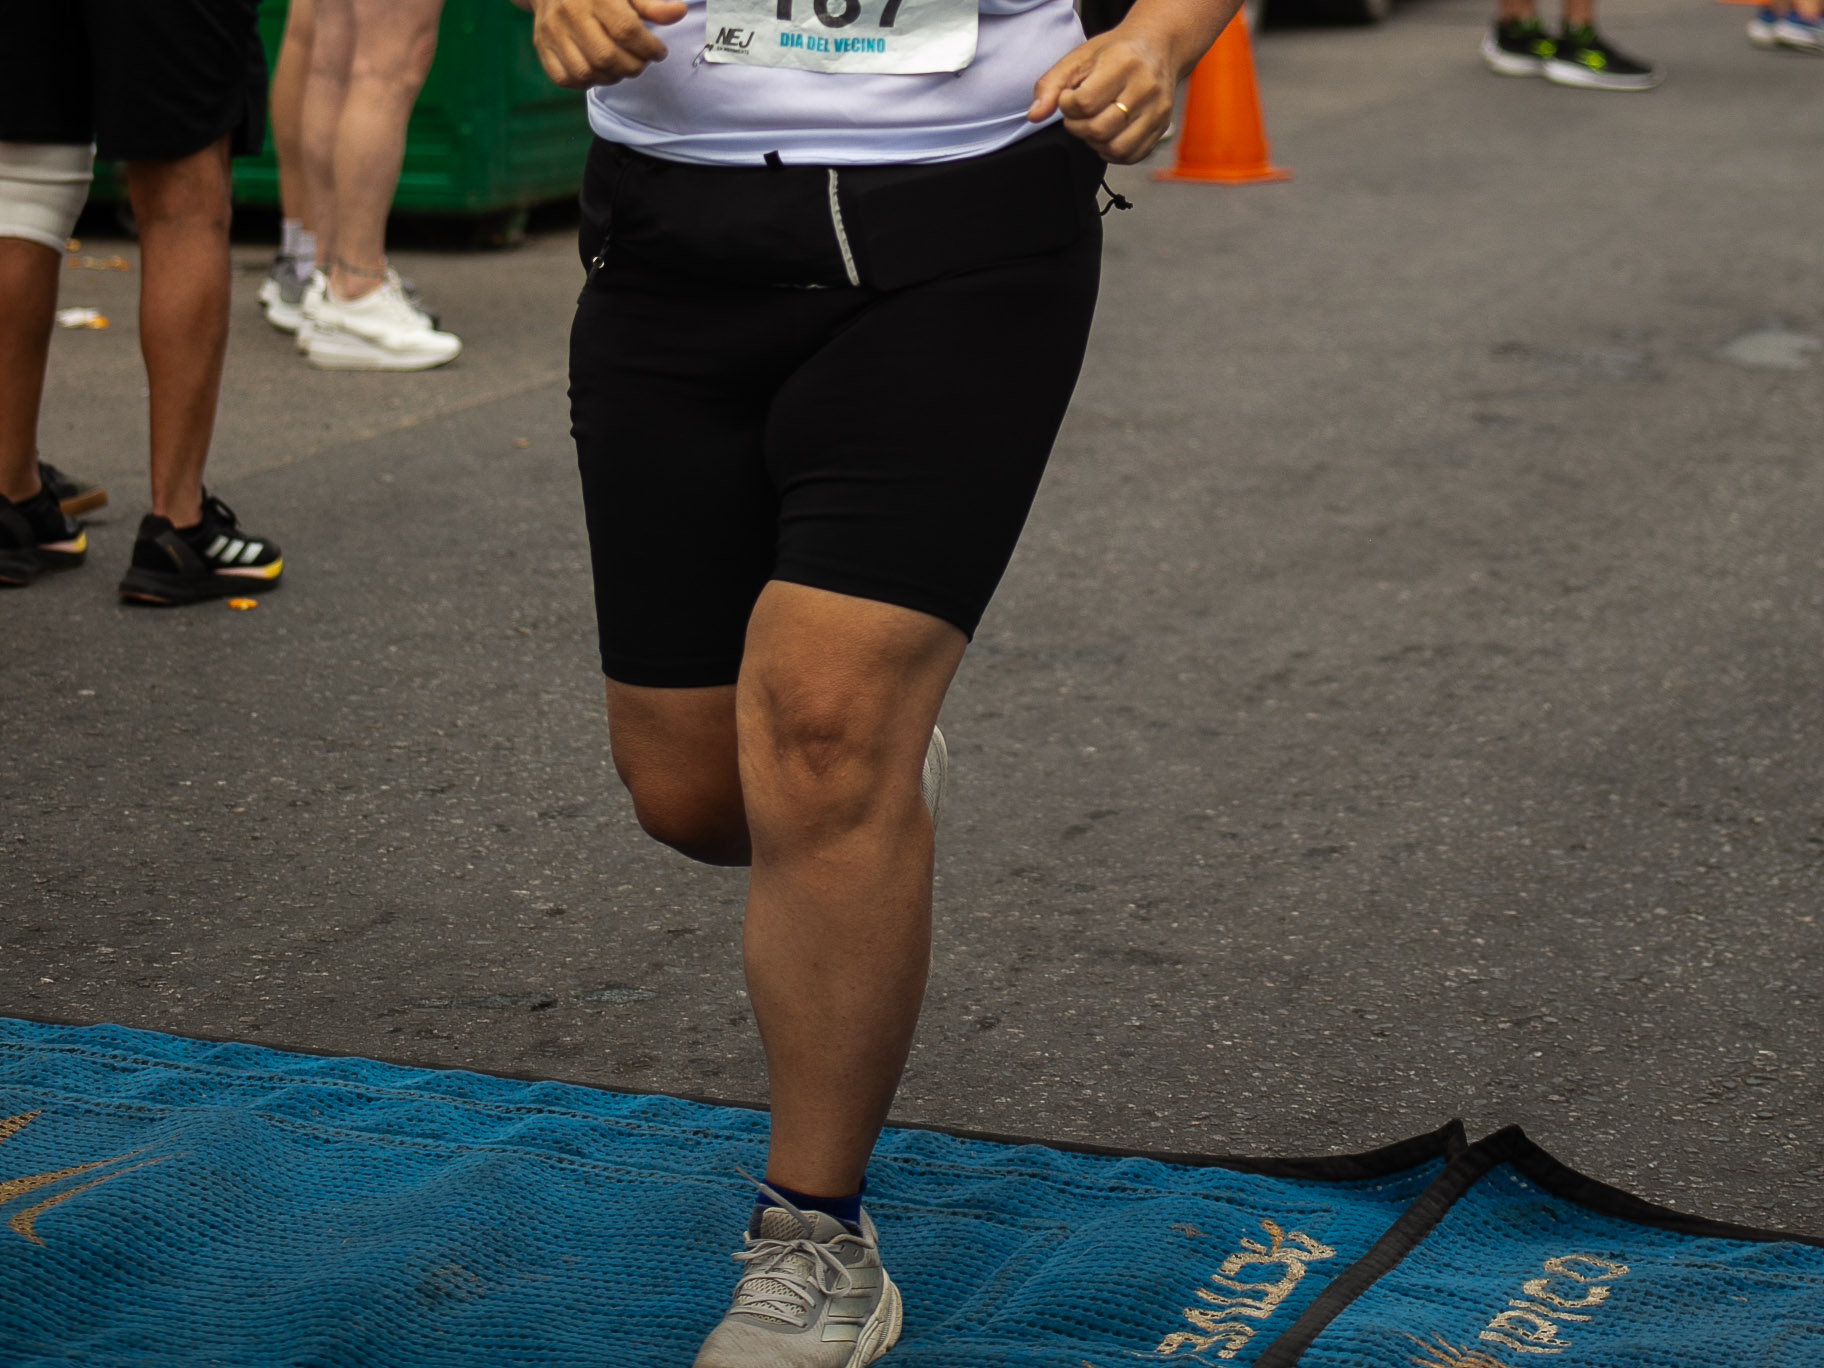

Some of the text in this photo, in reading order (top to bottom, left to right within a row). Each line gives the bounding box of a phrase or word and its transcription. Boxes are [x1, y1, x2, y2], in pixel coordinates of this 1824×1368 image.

[715, 26, 755, 49] NEJ
[780, 32, 886, 53] DIA DEL VECINO
